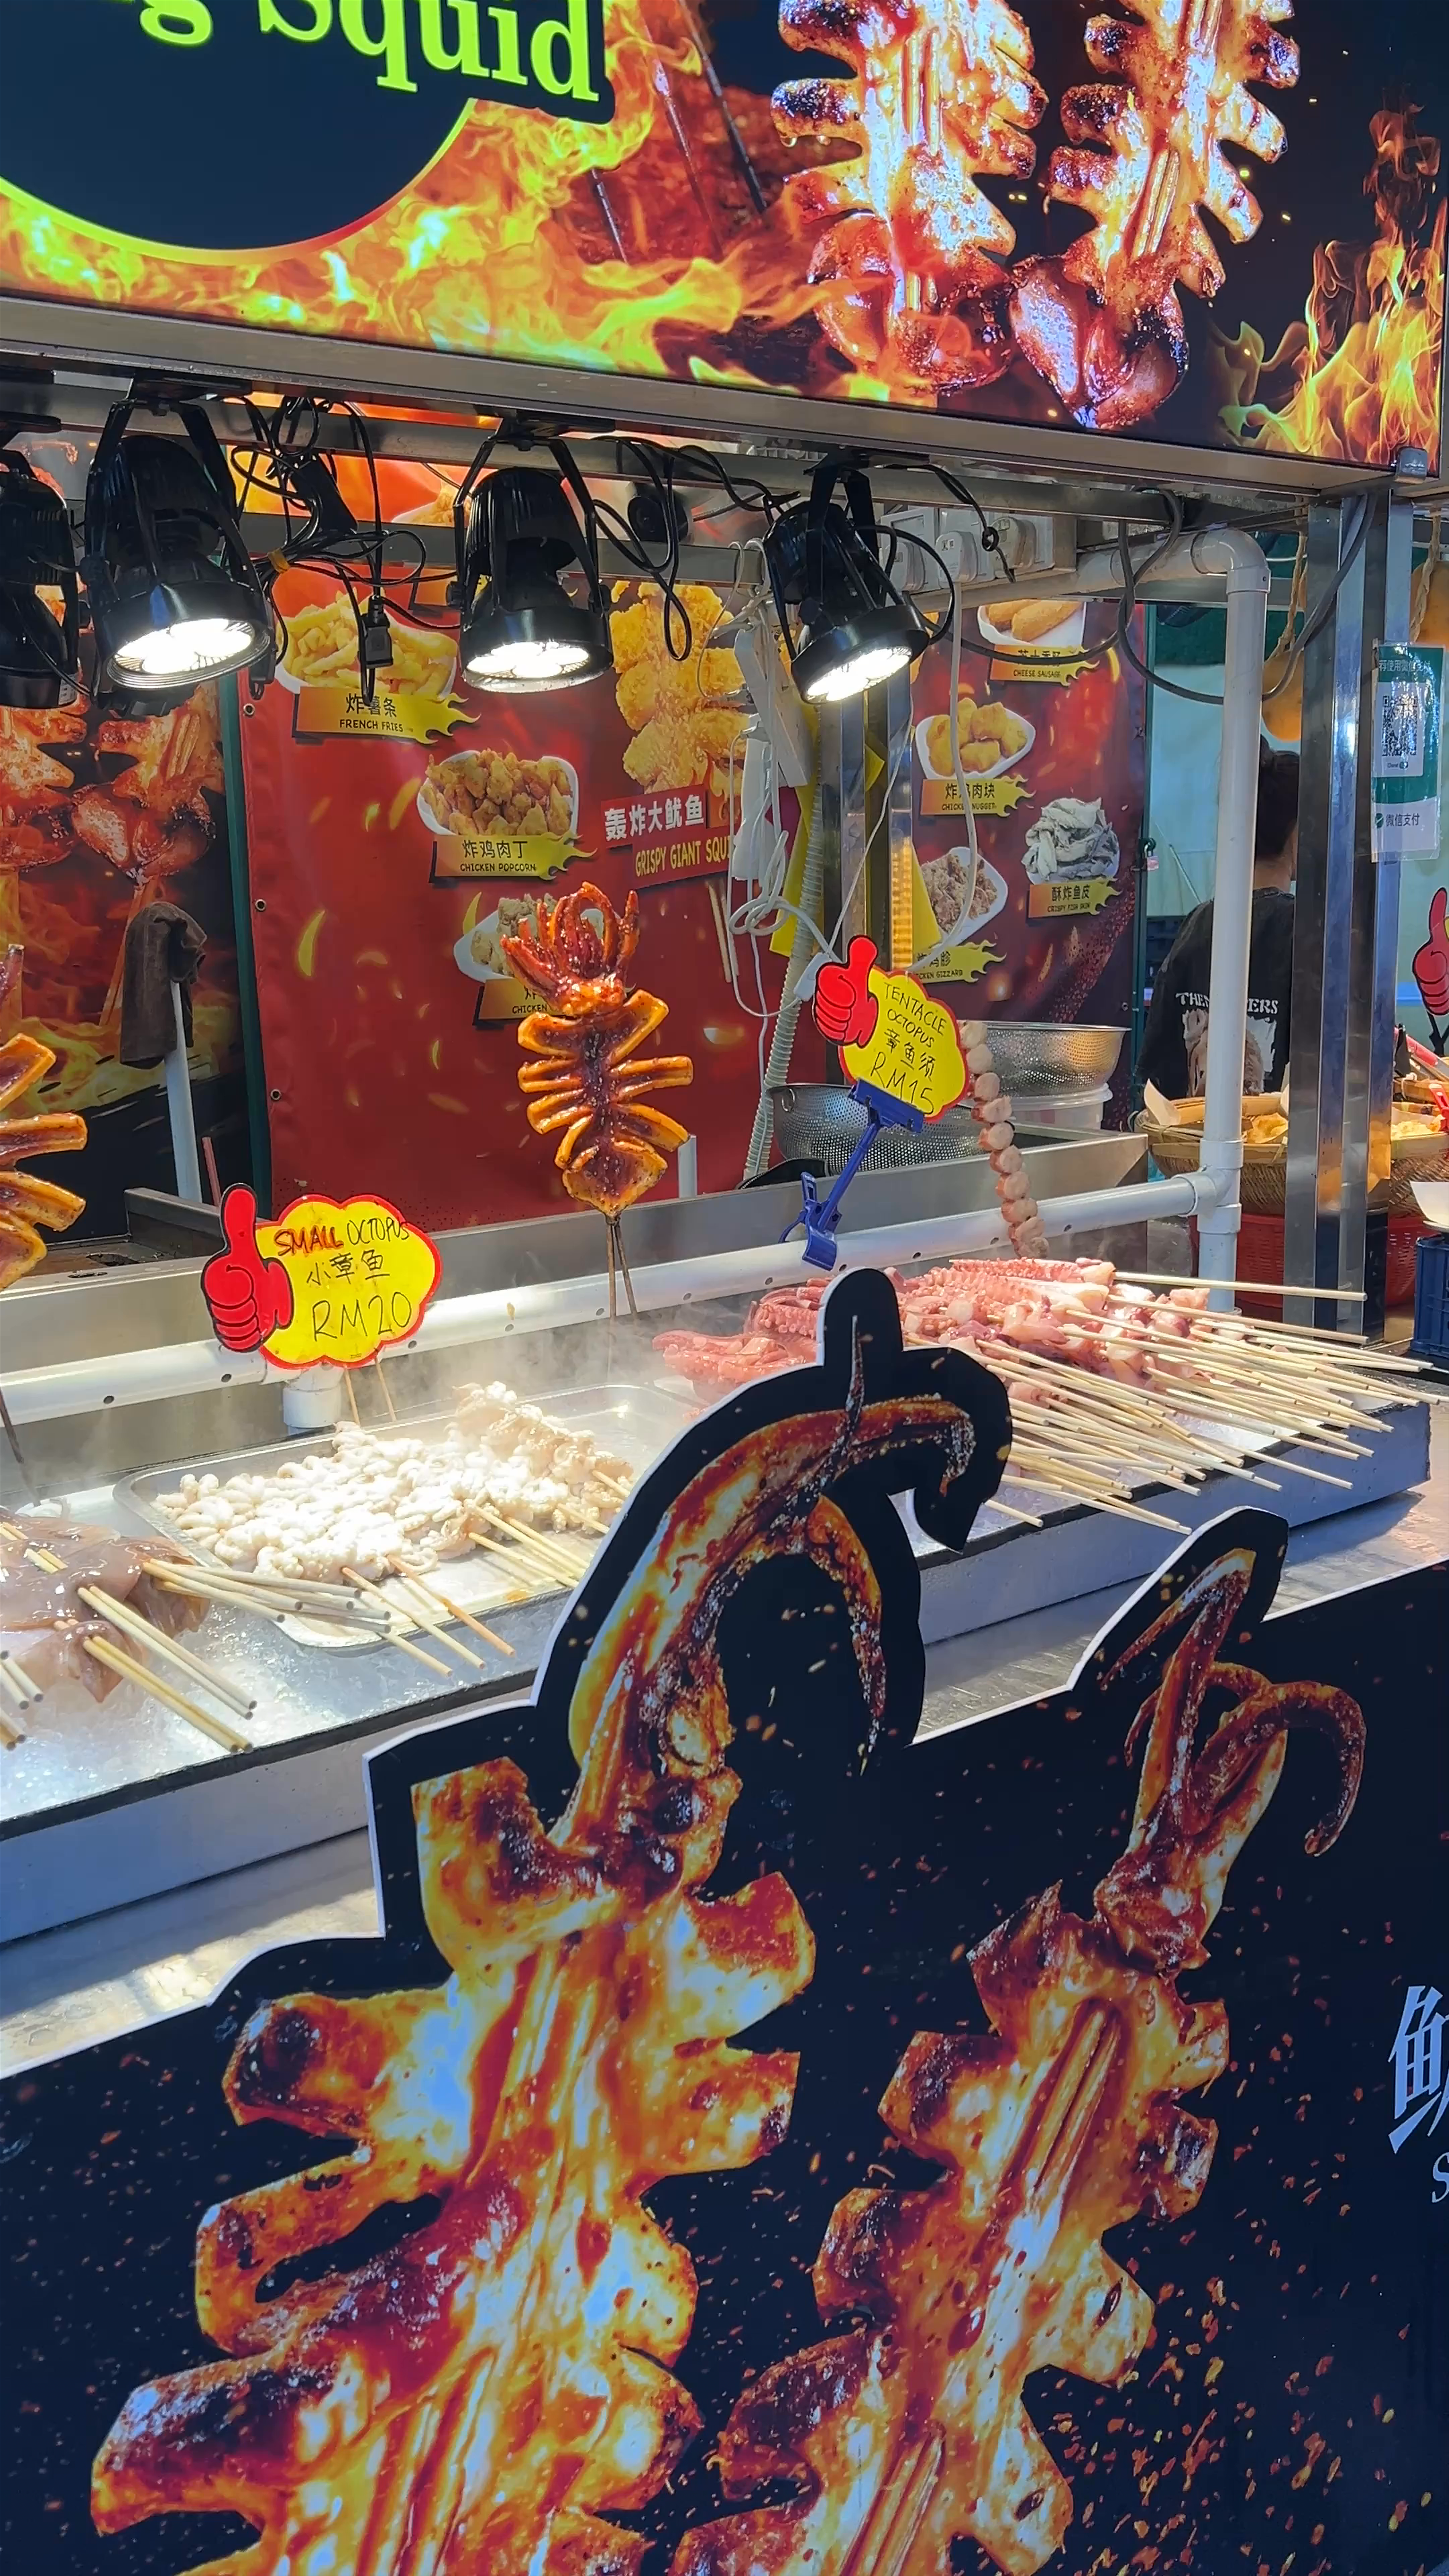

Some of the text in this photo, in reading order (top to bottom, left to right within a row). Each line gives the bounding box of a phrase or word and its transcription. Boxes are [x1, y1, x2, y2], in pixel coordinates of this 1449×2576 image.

[340, 719, 403, 732] FRENCH FRIES
[605, 795, 704, 841] 轰炸大鱿鱼
[1386, 812, 1420, 827] 微信支付
[462, 839, 528, 859] 炸鸡肉丁
[670, 840, 701, 870] GIANT
[460, 863, 537, 872] CHICKEN POPCORN
[936, 969, 963, 978] GIZZARD
[512, 1004, 548, 1014] CHICKEN
[884, 982, 947, 1036] TENTACLE
[887, 1009, 935, 1049] OCTOPUS
[870, 1051, 934, 1115] RM15
[274, 1217, 410, 1257] SMALL OCTOPUS
[306, 1249, 391, 1286] 小章鱼
[312, 1292, 412, 1342] RM20
